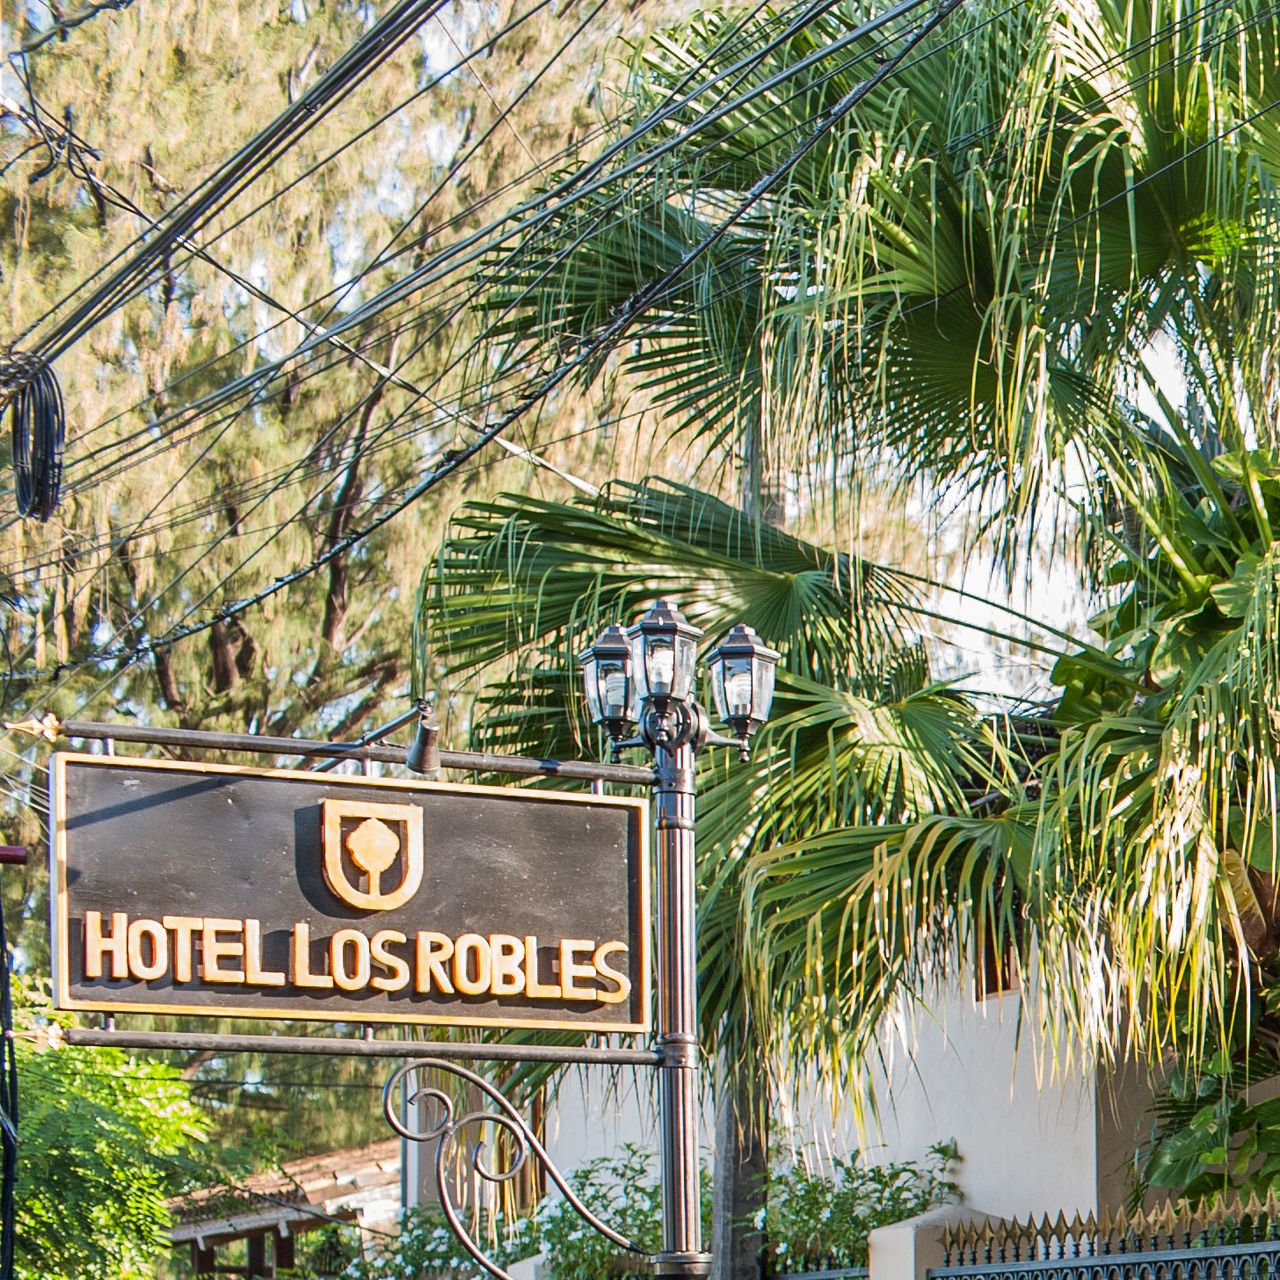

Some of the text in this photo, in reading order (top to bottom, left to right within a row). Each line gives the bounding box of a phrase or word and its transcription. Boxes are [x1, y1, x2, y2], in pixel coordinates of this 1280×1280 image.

[85, 911, 632, 1004] HOTEL LOS ROBLES
